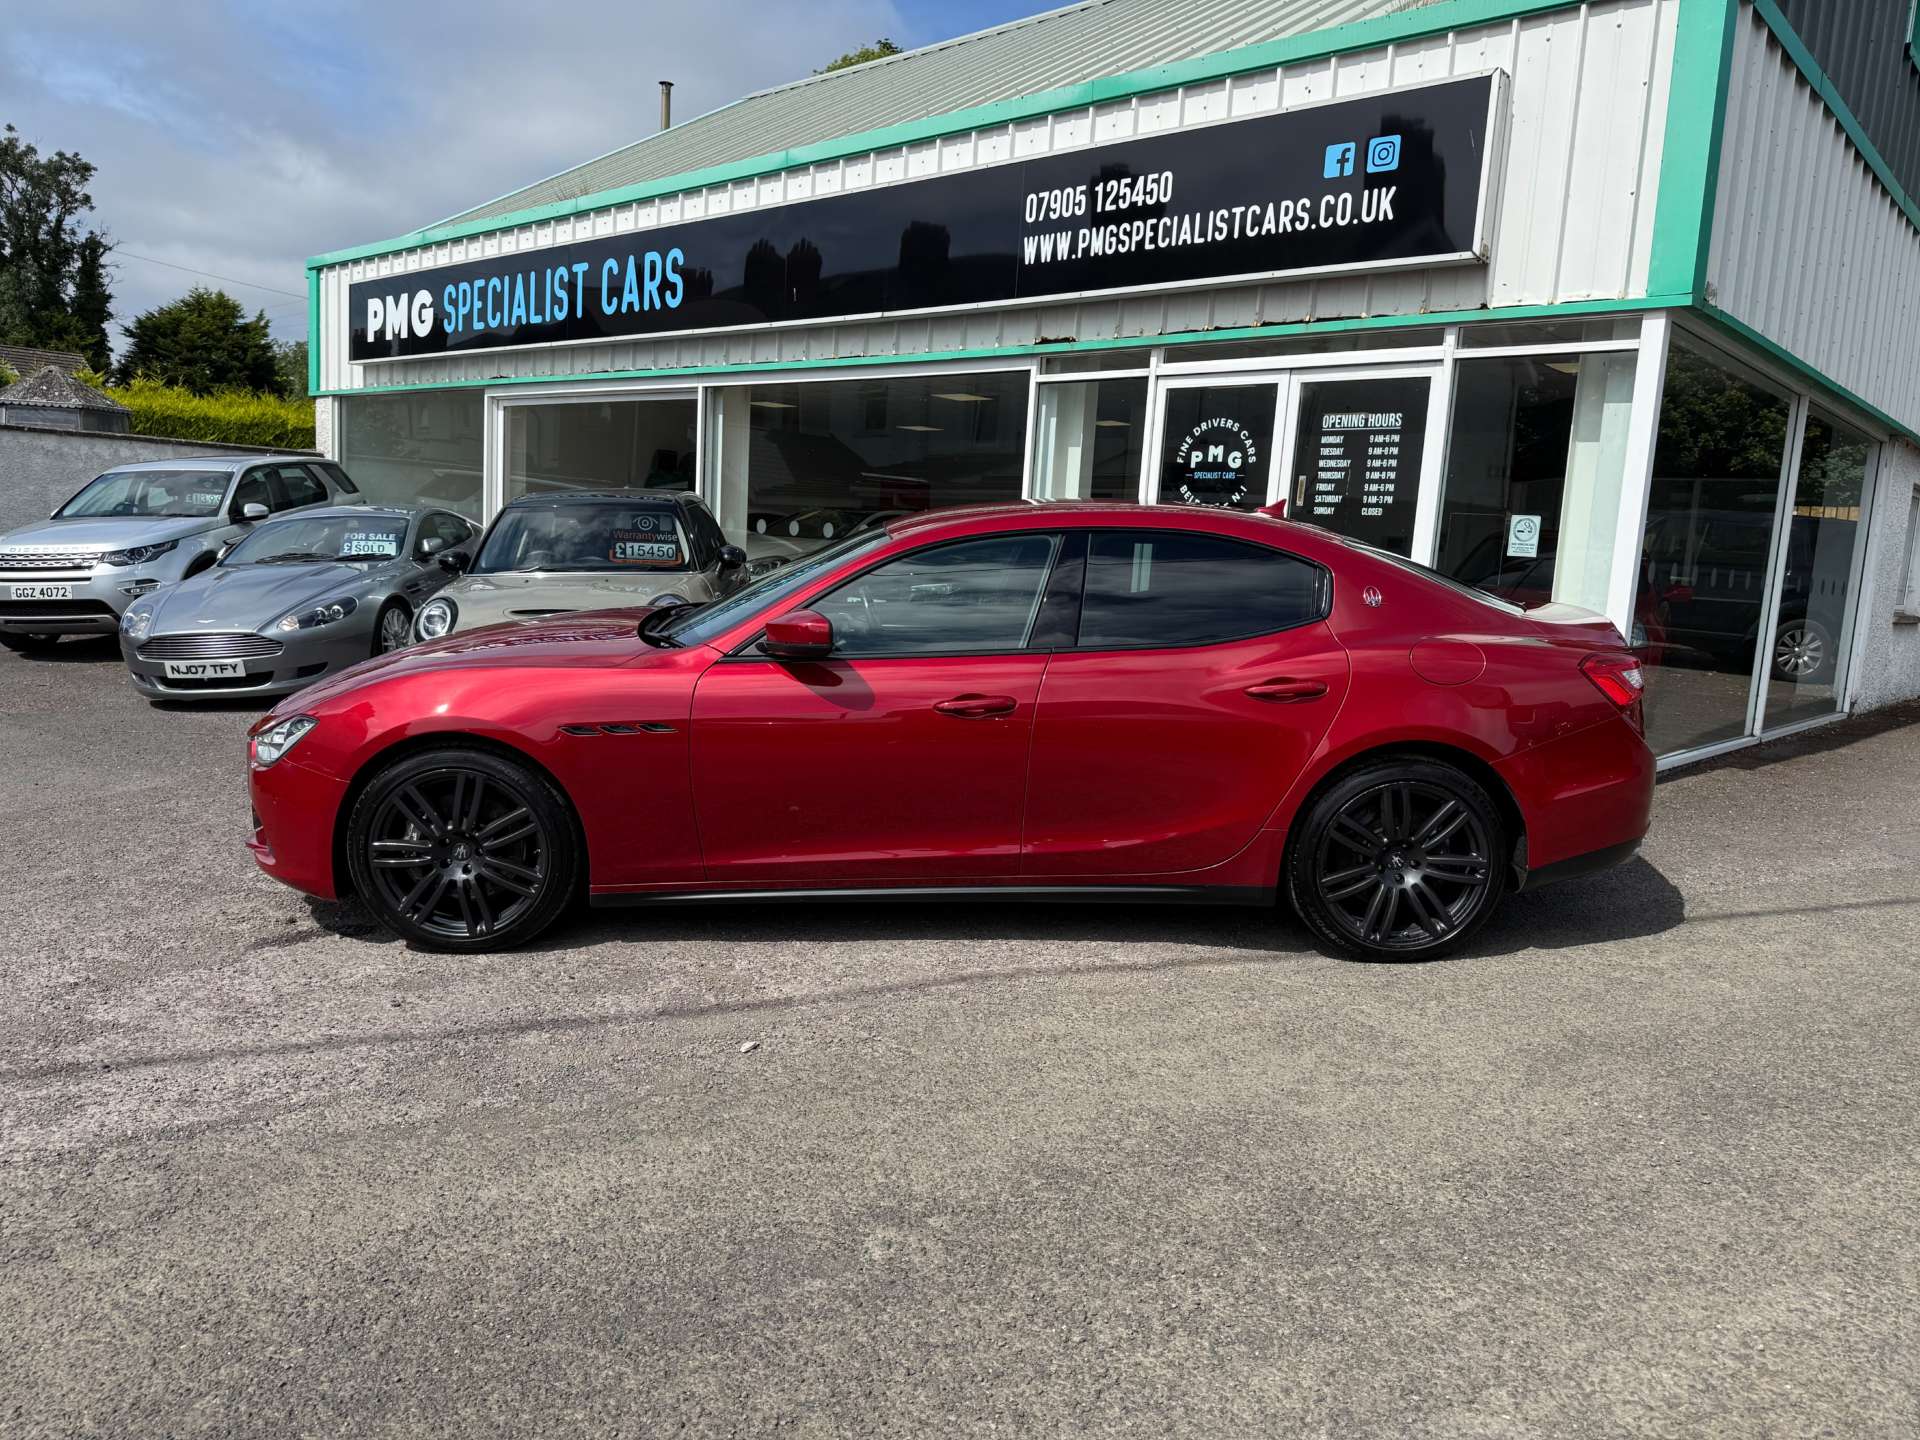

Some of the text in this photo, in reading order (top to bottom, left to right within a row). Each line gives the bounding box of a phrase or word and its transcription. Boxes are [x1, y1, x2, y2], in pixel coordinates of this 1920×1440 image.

[1025, 170, 1174, 224] 07905 125450
[1023, 186, 1398, 265] WWW.PMGSPECIALISTCARS.CO.UK
[366, 247, 685, 343] PMG SPECIALIST CARS
[1322, 412, 1403, 429] OPENING HOURS
[1176, 417, 1257, 464] FINE DRIVERS CARS
[1320, 435, 1345, 444] MONDAY
[1390, 434, 1401, 443] PM
[1189, 444, 1243, 469] PMG
[1320, 447, 1345, 456] TUESDAY
[1388, 446, 1399, 455] PM
[1318, 459, 1352, 468] WEDNESDAY
[1387, 459, 1398, 467] PM
[1193, 471, 1236, 479] SPECIALIST CARS
[1317, 471, 1346, 480] THURSDAY
[1386, 471, 1397, 480] PM
[1315, 483, 1336, 492] FRIDAY
[1384, 483, 1395, 492] PM
[1314, 495, 1343, 503] SATURDAY
[1383, 495, 1394, 504] PM
[1313, 507, 1383, 516] SUNDAY CLOSED
[343, 532, 397, 541] FOR SALE
[612, 528, 679, 542] Warrantywise
[354, 544, 385, 553] SOLD
[615, 542, 676, 559] £15450
[15, 586, 68, 599] GGZ 4072
[170, 663, 239, 675] NJ07 TFY
